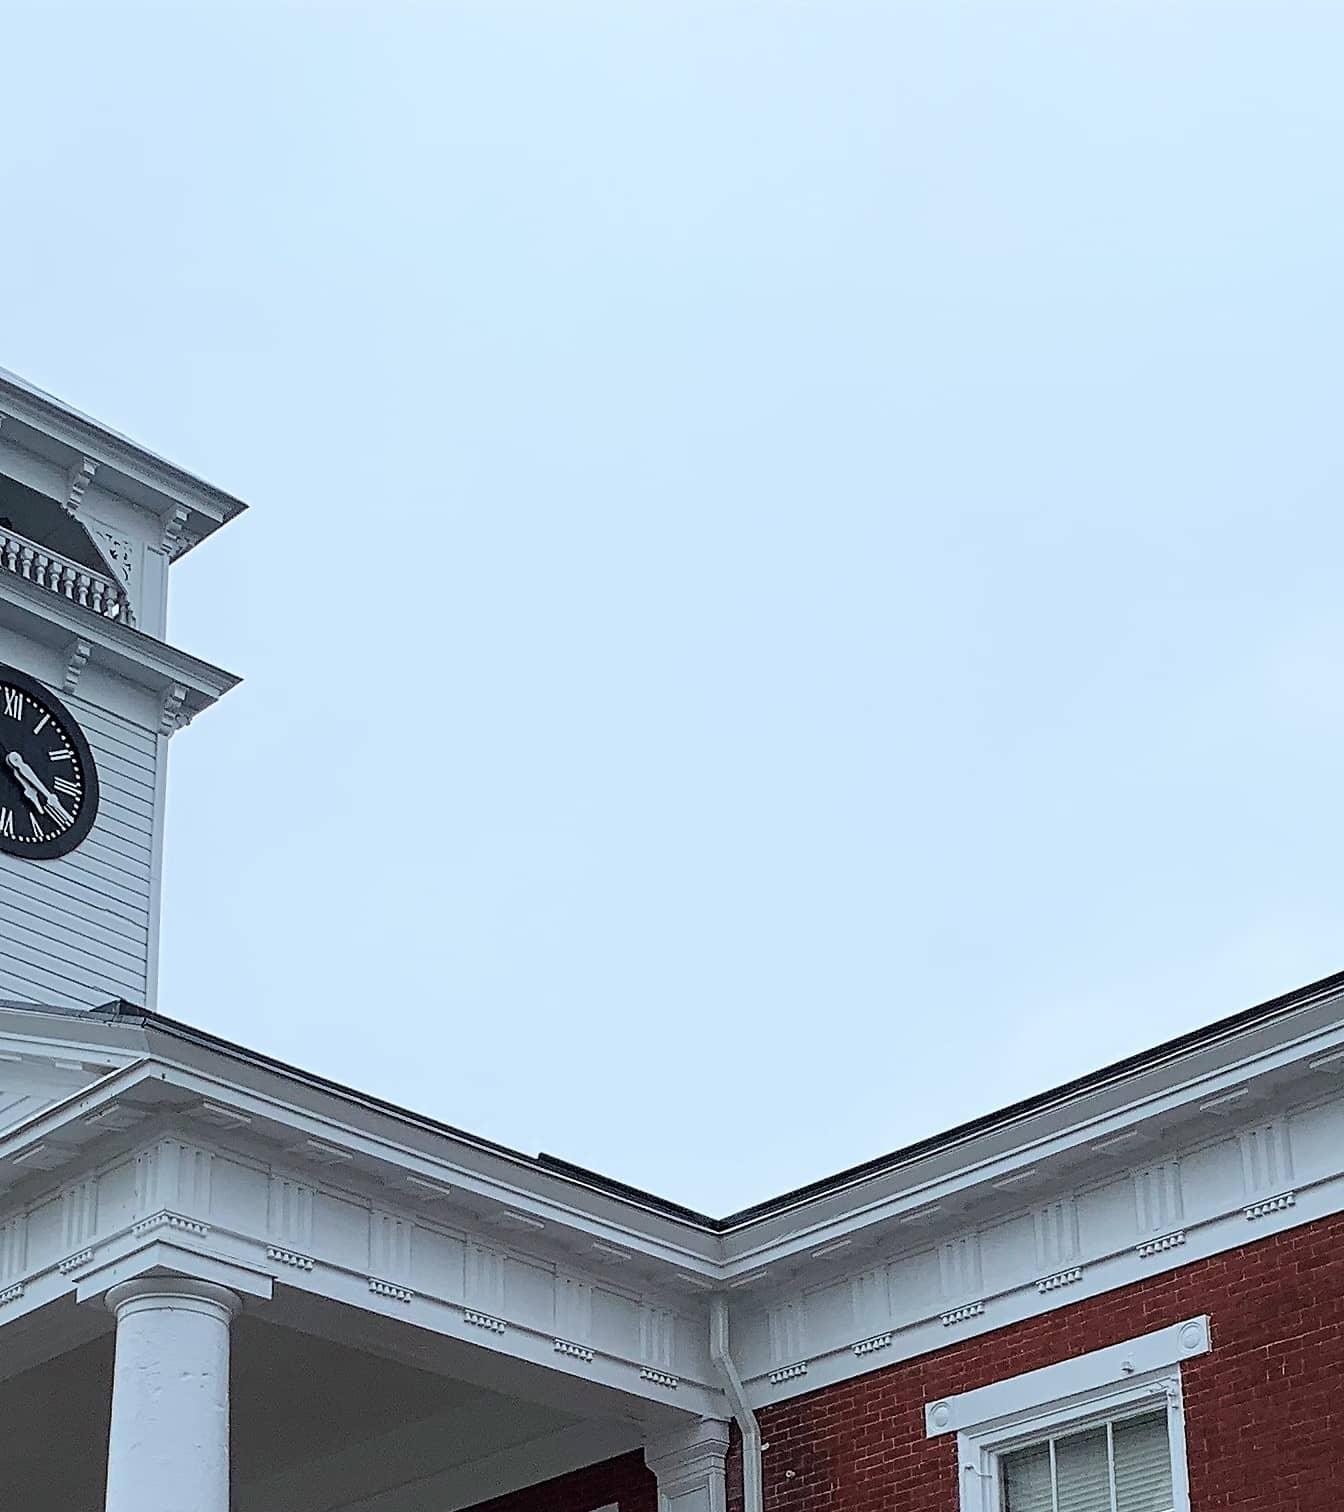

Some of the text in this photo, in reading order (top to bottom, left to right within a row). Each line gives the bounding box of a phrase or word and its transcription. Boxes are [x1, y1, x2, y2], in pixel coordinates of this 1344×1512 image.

[4, 686, 24, 720] XII
[33, 714, 51, 734] I
[48, 749, 73, 761] II
[54, 776, 81, 796] III
[0, 807, 14, 836] VI
[30, 812, 44, 838] V
